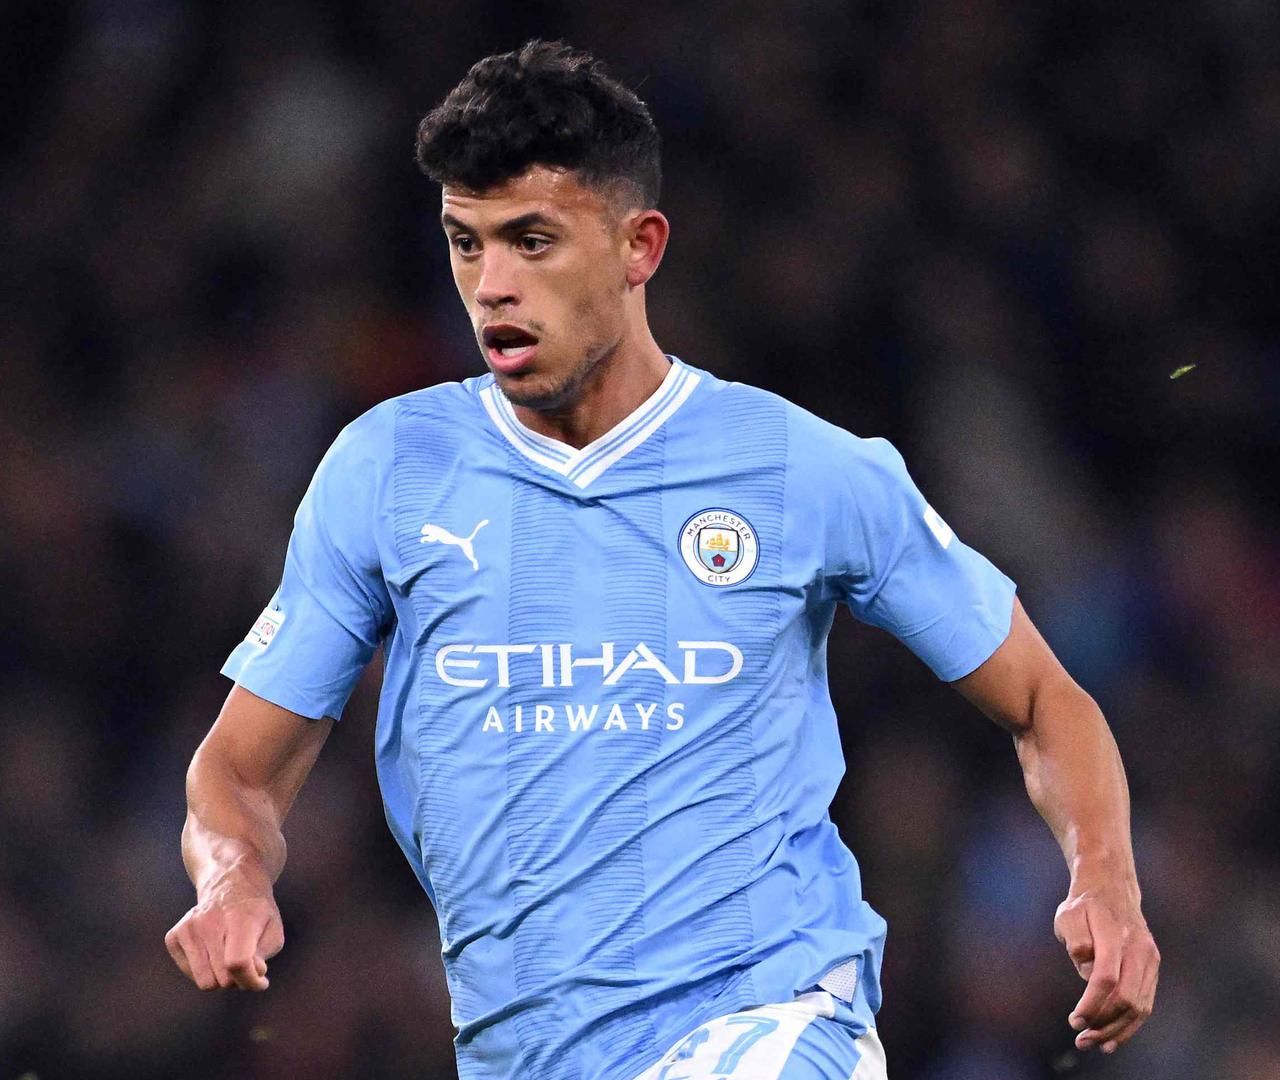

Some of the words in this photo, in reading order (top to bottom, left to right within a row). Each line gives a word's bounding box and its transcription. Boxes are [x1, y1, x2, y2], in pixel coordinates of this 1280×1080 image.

[687, 514, 751, 541] MANCHESTER
[707, 574, 731, 583] CITY
[435, 640, 744, 688] ETIHAD
[482, 702, 685, 733] AIRWAYS
